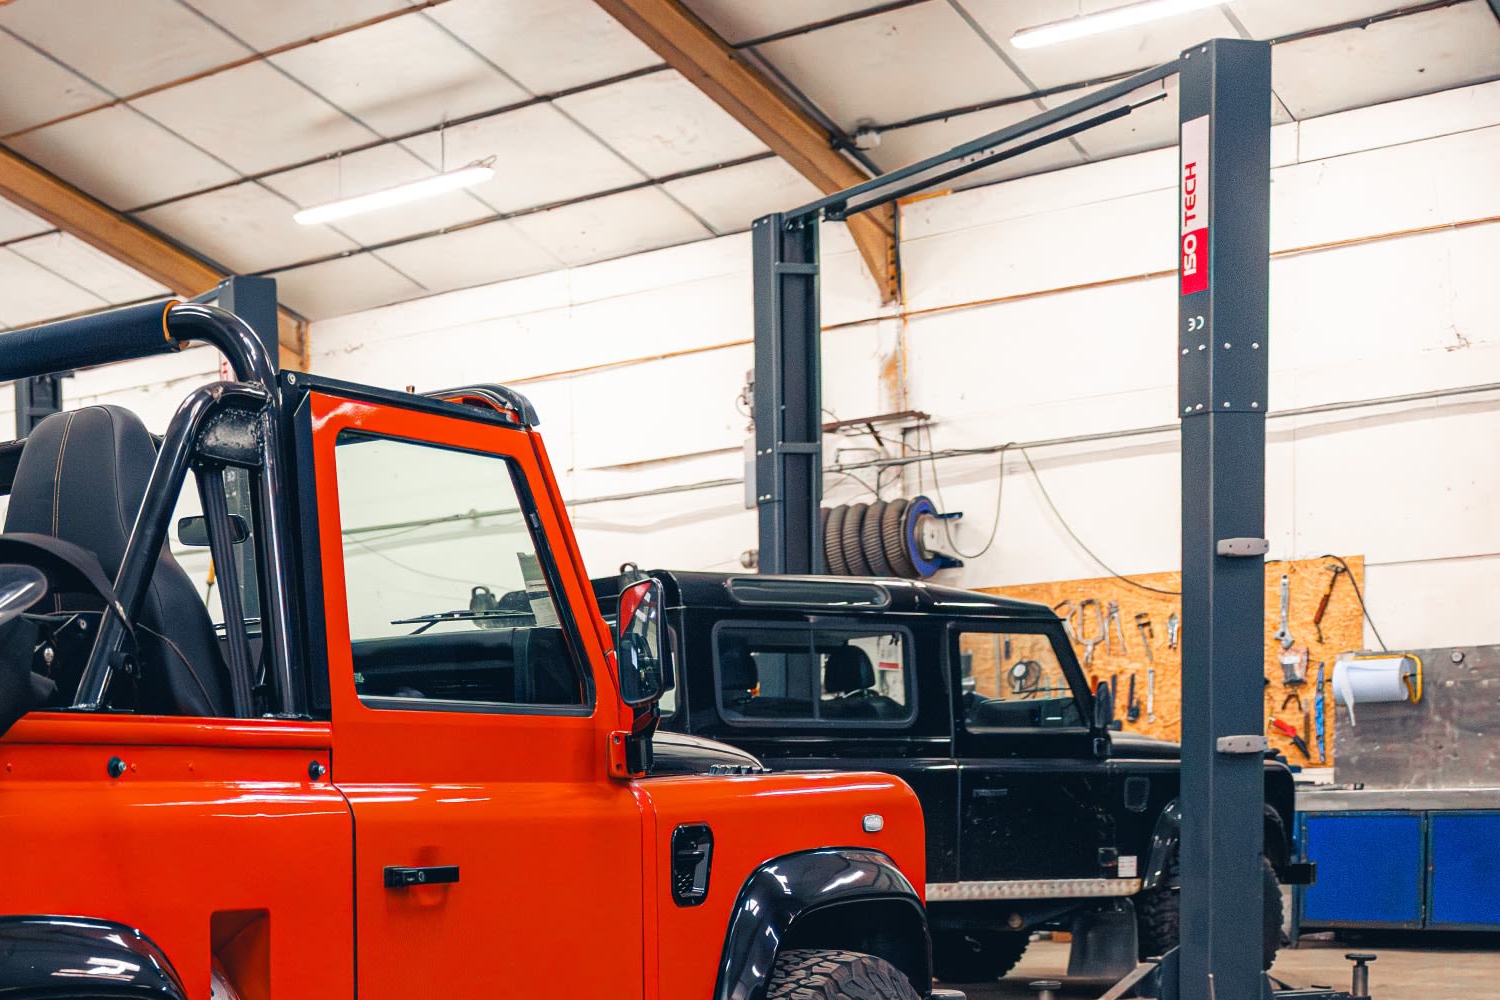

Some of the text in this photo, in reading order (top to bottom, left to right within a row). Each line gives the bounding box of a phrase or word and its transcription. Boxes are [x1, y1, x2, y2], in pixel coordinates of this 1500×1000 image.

[1183, 161, 1197, 277] ISO TECH
[1187, 315, 1205, 332] CE
